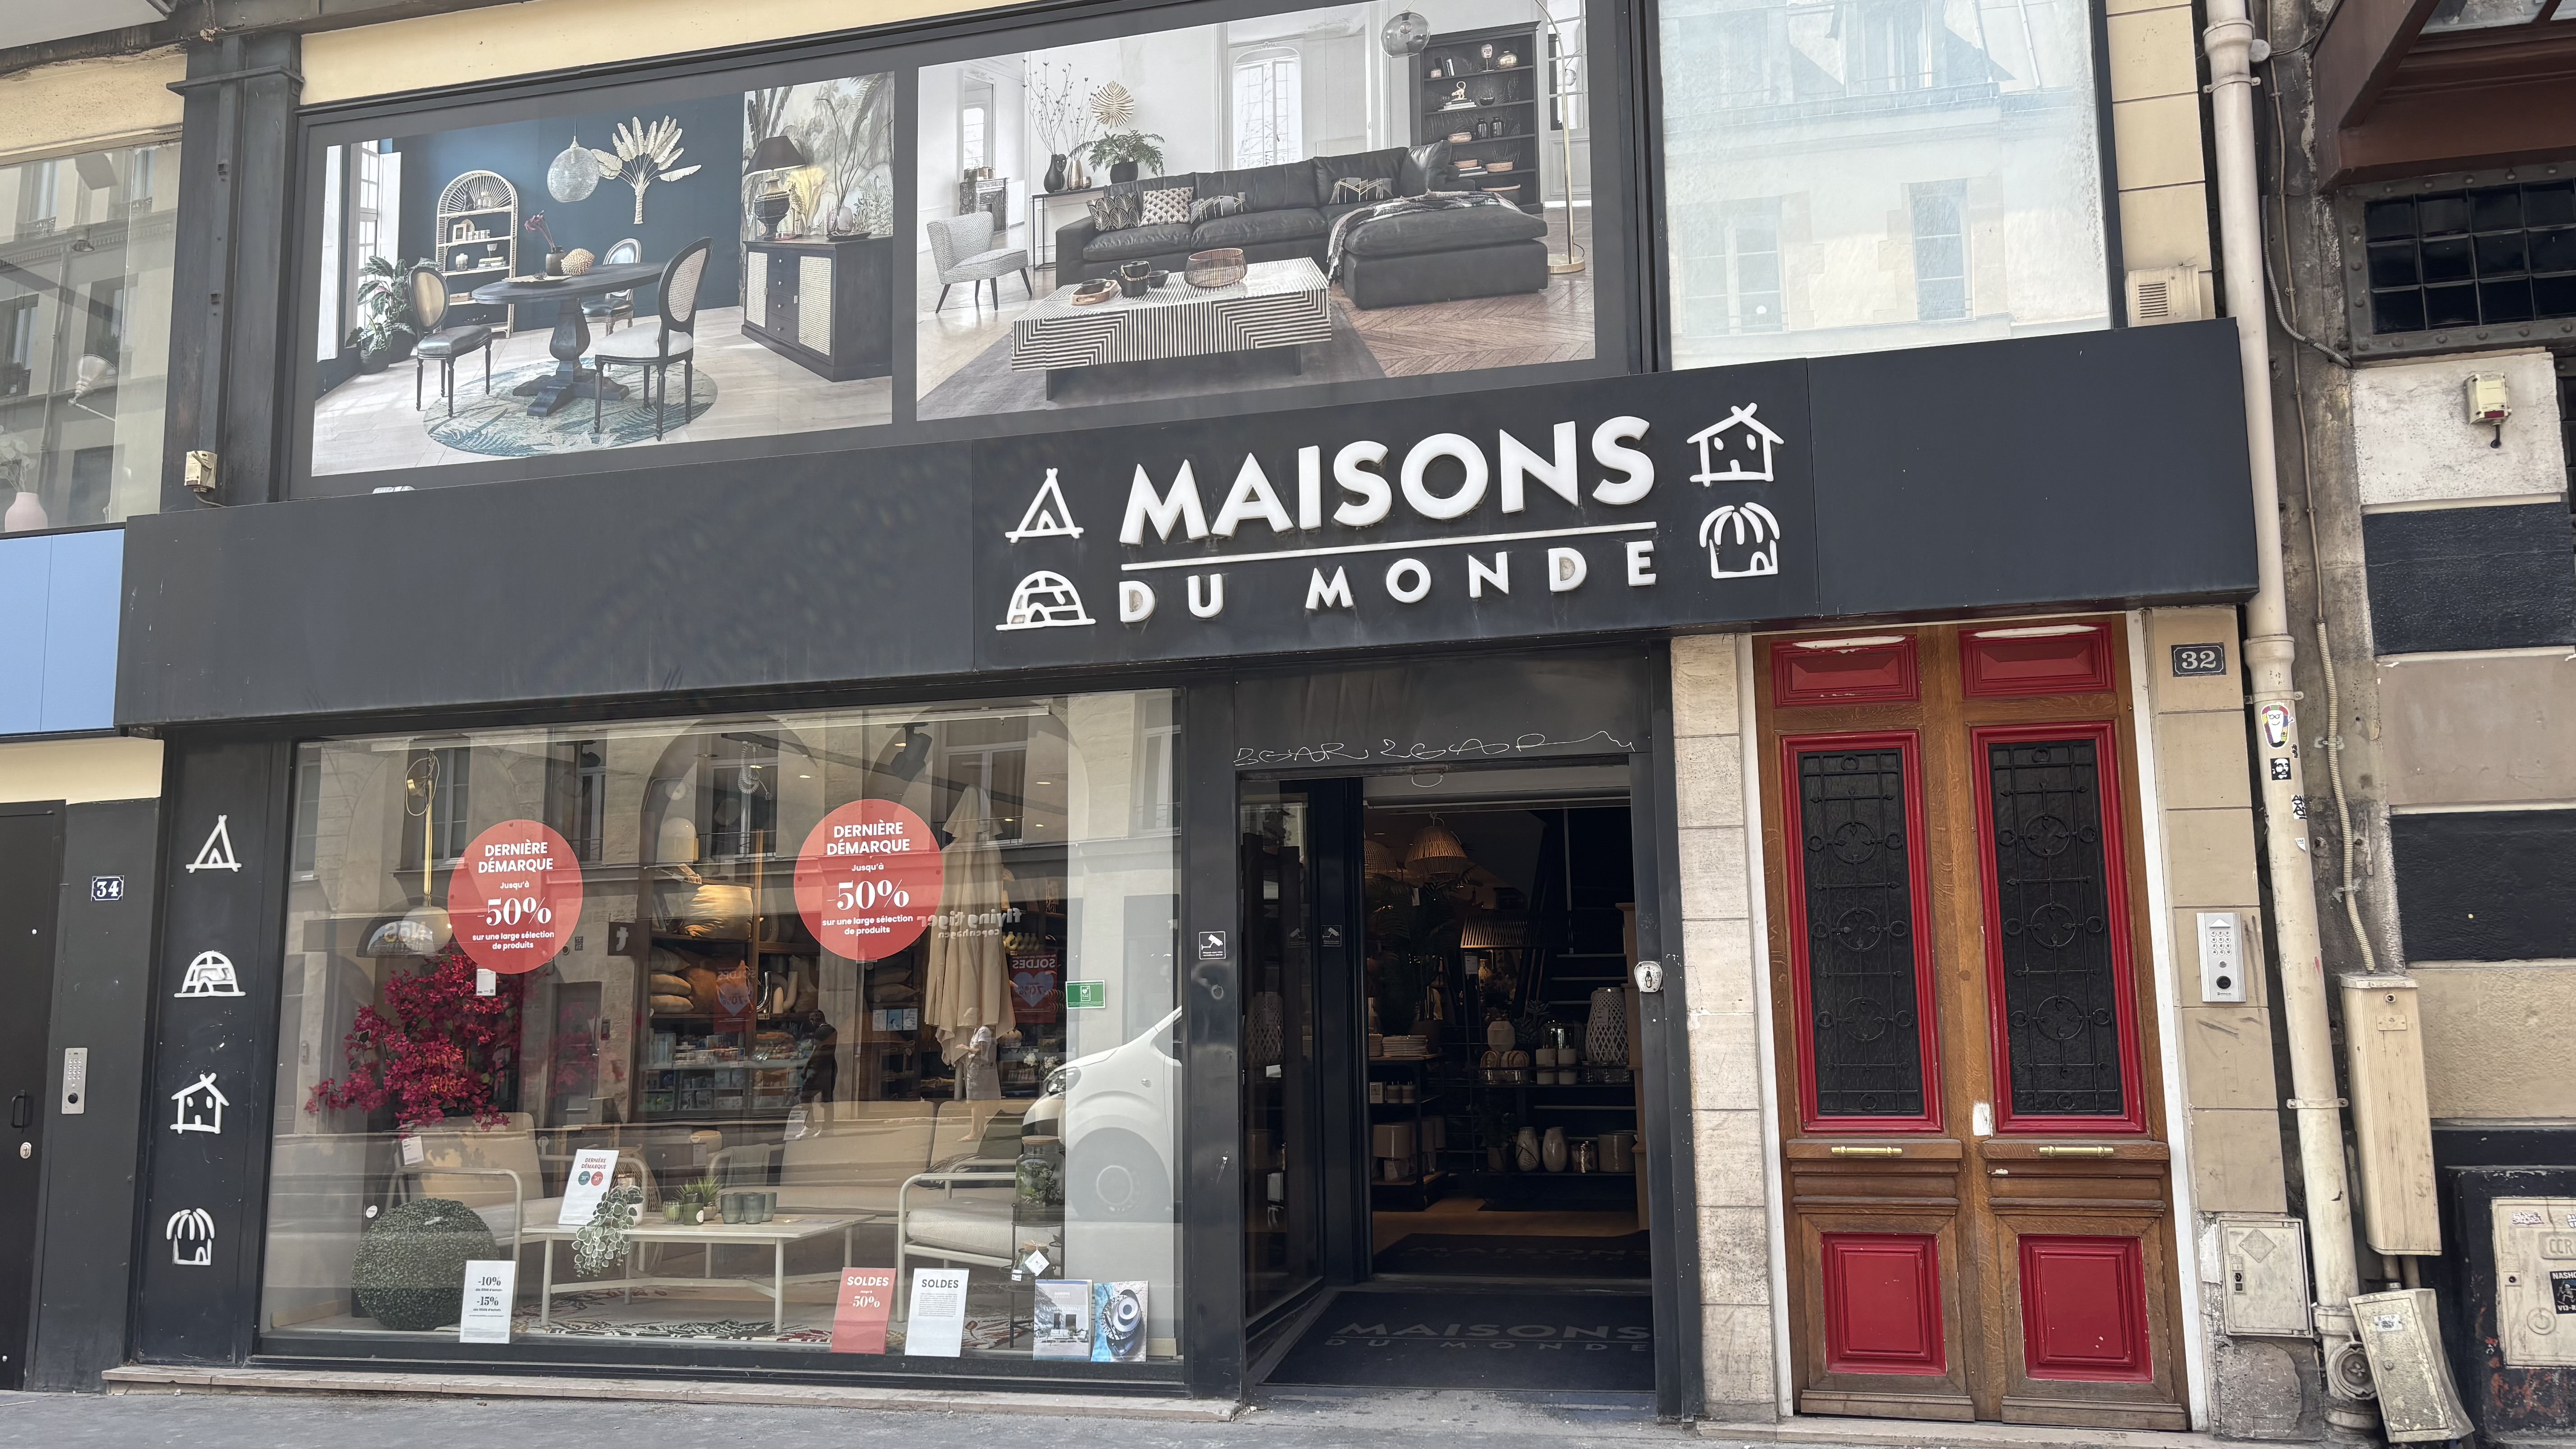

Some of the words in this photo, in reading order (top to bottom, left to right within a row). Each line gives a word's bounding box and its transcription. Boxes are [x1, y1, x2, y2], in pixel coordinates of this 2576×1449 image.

[1119, 415, 1655, 545] MAISONS
[1119, 573, 1225, 623] DU
[1304, 540, 1657, 611] MONDE
[2181, 650, 2216, 669] 32
[834, 819, 903, 838] DERNIÈRE
[485, 839, 548, 857] DERNIÈRE
[827, 838, 910, 856] DÉMARQUE
[478, 857, 553, 874] DÉMARQUE
[97, 881, 120, 897] 34
[827, 879, 909, 911] -50%
[477, 897, 552, 926] -50%
[853, 917, 874, 926] large
[876, 915, 913, 924] sélection
[501, 932, 520, 941] large
[521, 930, 554, 939] sélection
[856, 926, 890, 936] produits
[503, 941, 534, 951] produits
[478, 1277, 501, 1286] -10%
[847, 1276, 889, 1287] SOLDES
[922, 1279, 959, 1288] SOLDES
[477, 1296, 498, 1306] -15%
[849, 1296, 880, 1308] -50%
[1335, 1323, 1651, 1339] MAISONS
[1325, 1338, 1390, 1347] DU
[1440, 1341, 1648, 1352] MONDE
